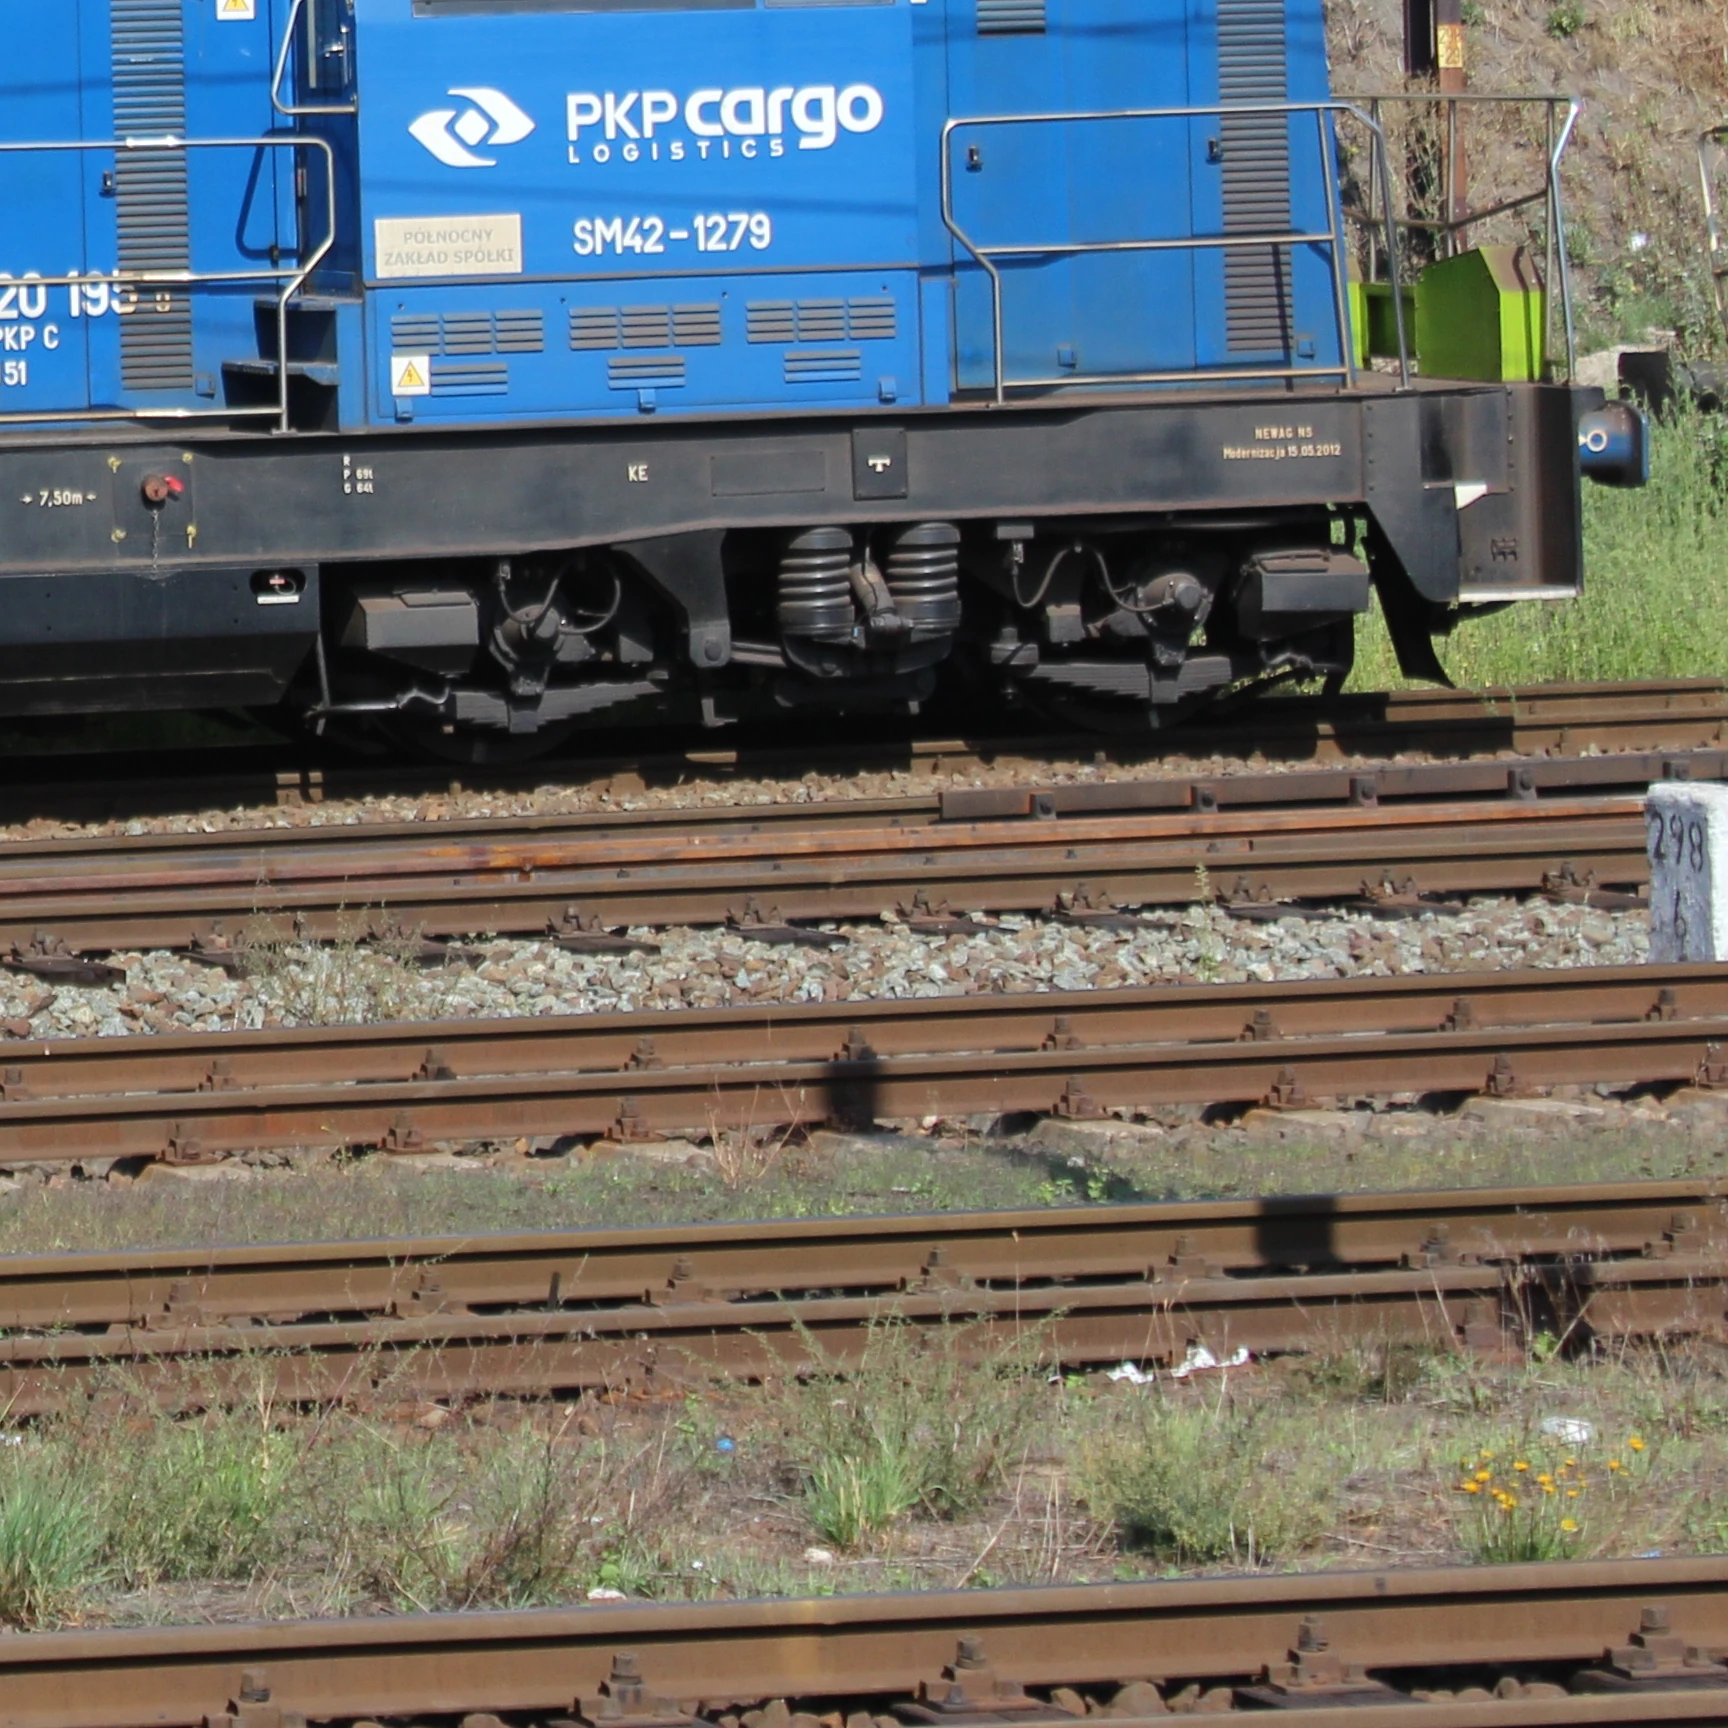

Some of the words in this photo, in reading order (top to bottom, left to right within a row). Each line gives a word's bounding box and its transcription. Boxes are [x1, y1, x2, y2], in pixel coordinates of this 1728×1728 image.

[566, 91, 678, 141] PKP
[685, 84, 883, 149] cargo
[568, 138, 784, 163] LOGISTICS
[403, 226, 494, 245] PÓŁNOCNY
[573, 213, 772, 255] SM42-1279
[384, 250, 448, 267] ZAKŁAD
[453, 246, 514, 265] SPÓŁKI
[1254, 427, 1293, 440] NEWAG
[1297, 426, 1313, 439] NS
[1223, 446, 1285, 460] Modernizacja
[628, 464, 649, 482] KE
[38, 490, 83, 508] 7,50m
[1648, 807, 1704, 873] 298
